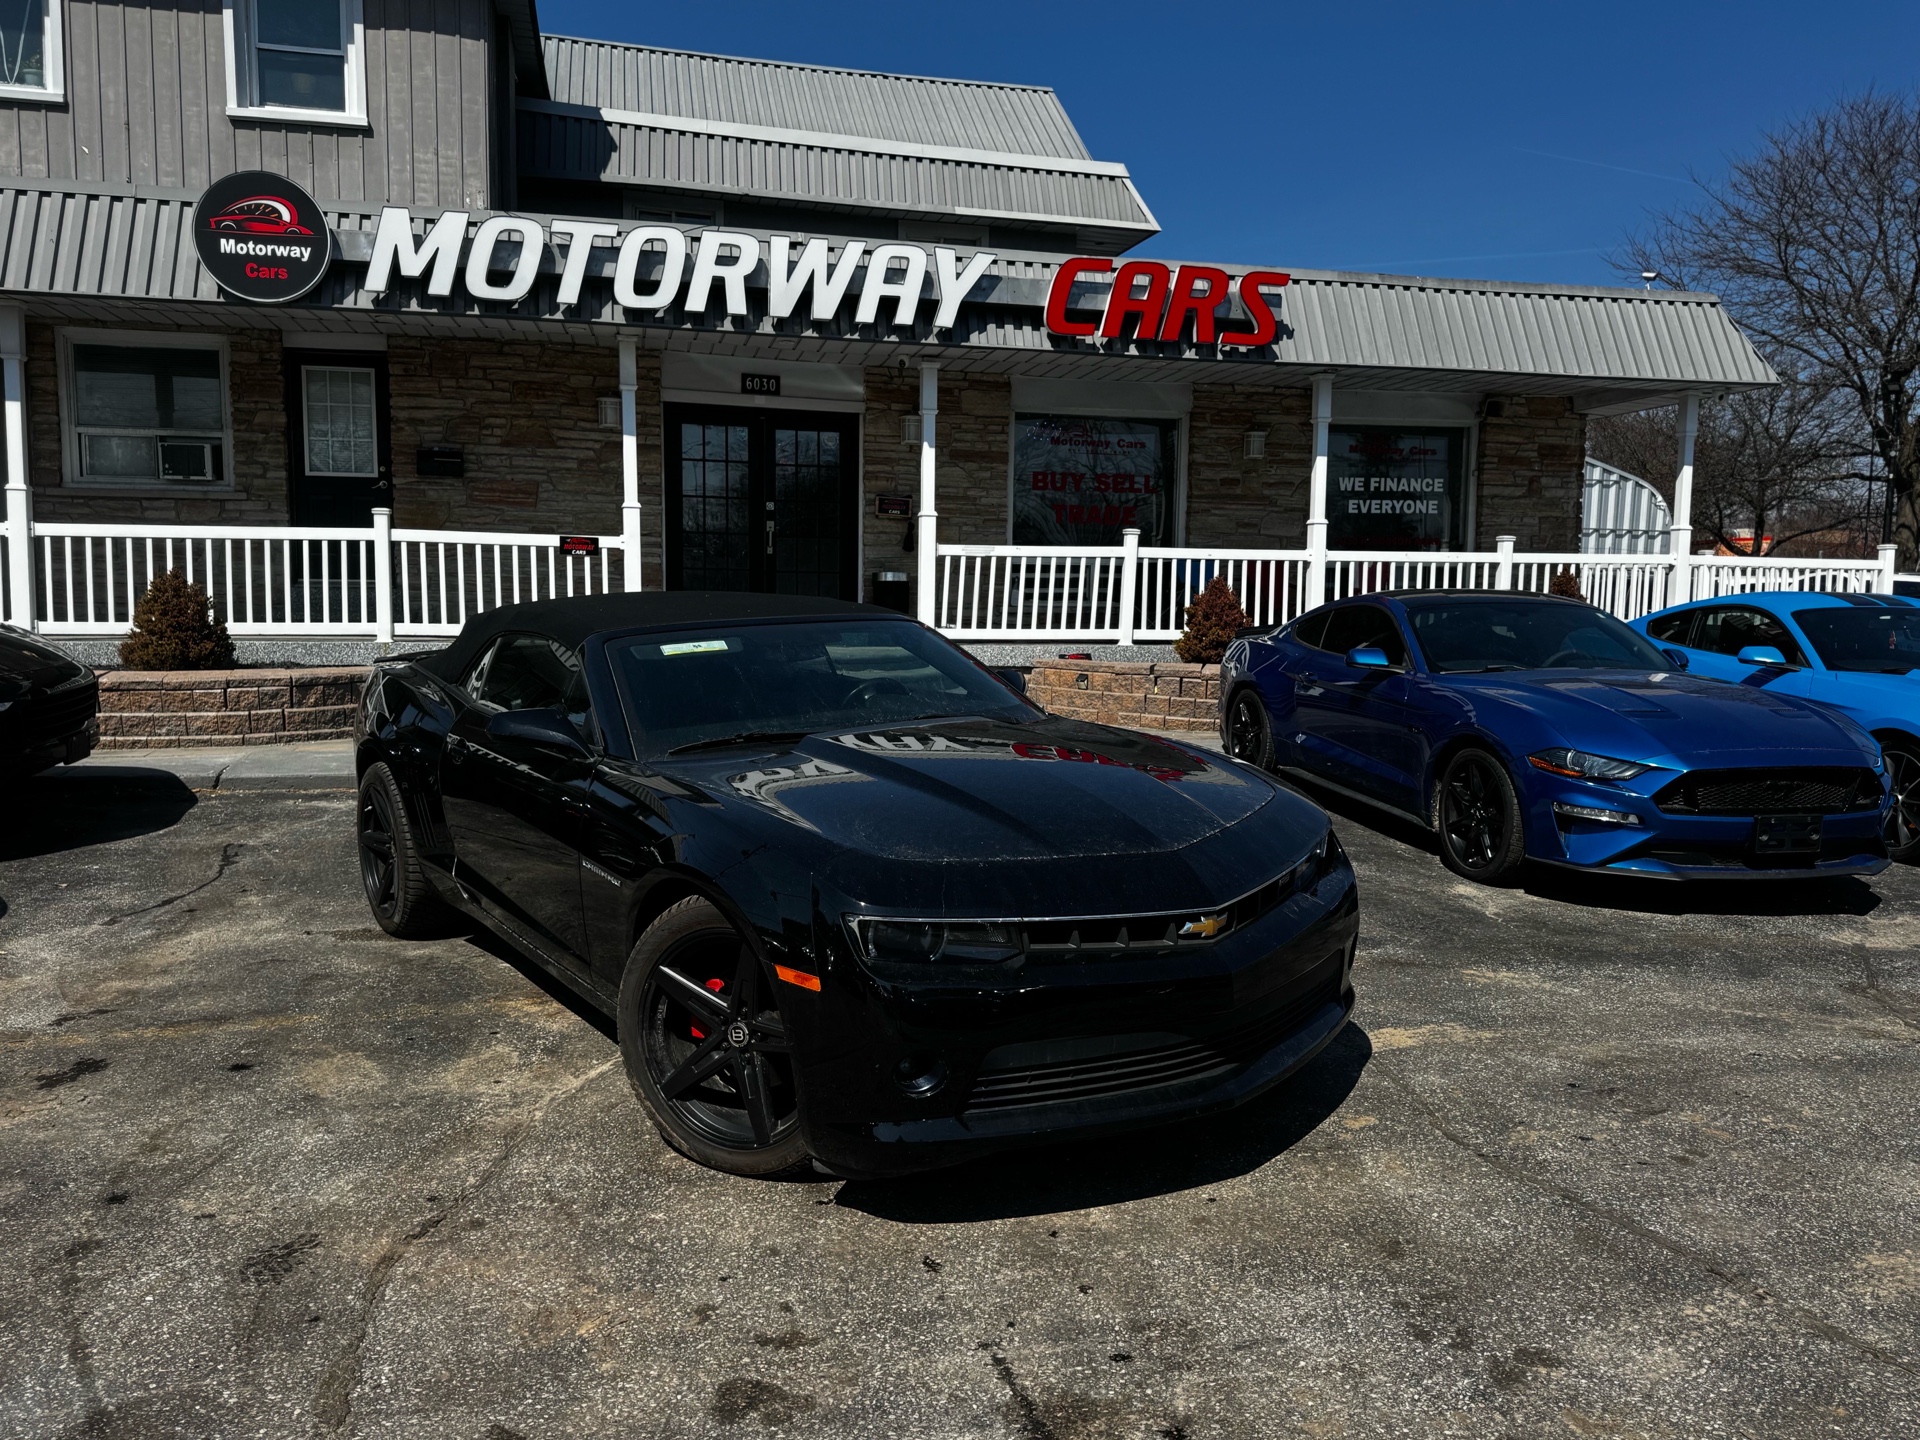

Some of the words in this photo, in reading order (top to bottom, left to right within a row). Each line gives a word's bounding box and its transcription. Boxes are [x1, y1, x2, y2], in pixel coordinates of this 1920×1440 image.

[220, 238, 312, 262] Motorway
[245, 262, 288, 280] Cars
[364, 207, 997, 328] MOTORWAY
[1044, 257, 1290, 346] CARS
[746, 377, 776, 392] 6030
[1050, 436, 1111, 449] Motorway
[1117, 438, 1146, 449] Cars
[1032, 471, 1086, 492] BUY
[1095, 472, 1158, 494] SELL
[1338, 477, 1365, 492] WE
[1369, 477, 1444, 492] FINANCE
[1052, 503, 1137, 525] TRADE
[1348, 499, 1439, 514] EVERYONE
